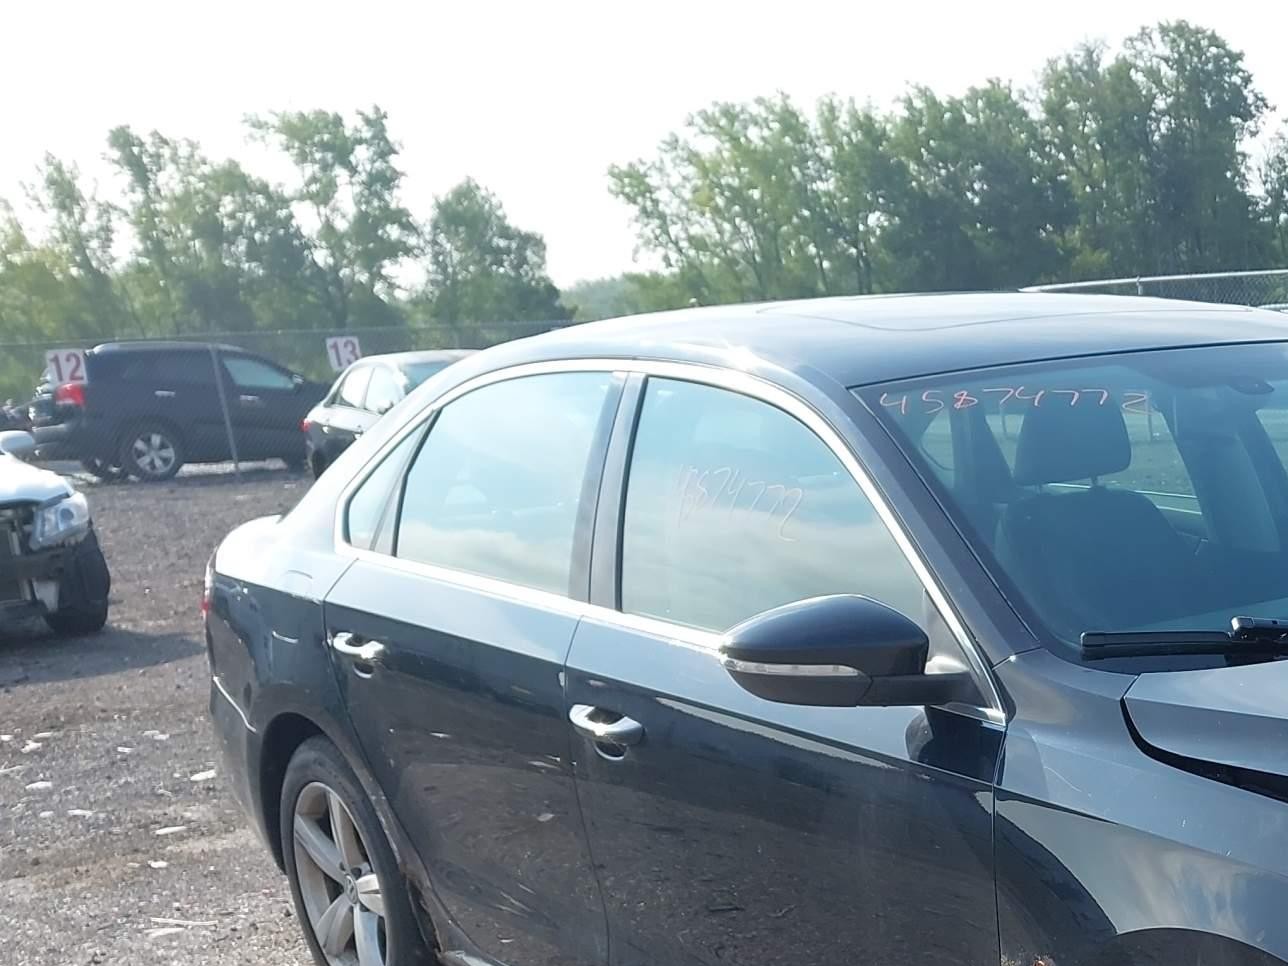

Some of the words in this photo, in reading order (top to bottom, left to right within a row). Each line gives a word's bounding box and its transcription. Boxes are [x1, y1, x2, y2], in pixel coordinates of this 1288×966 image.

[50, 351, 84, 382] 12
[329, 341, 361, 368] 13
[880, 385, 1153, 415] 45874772
